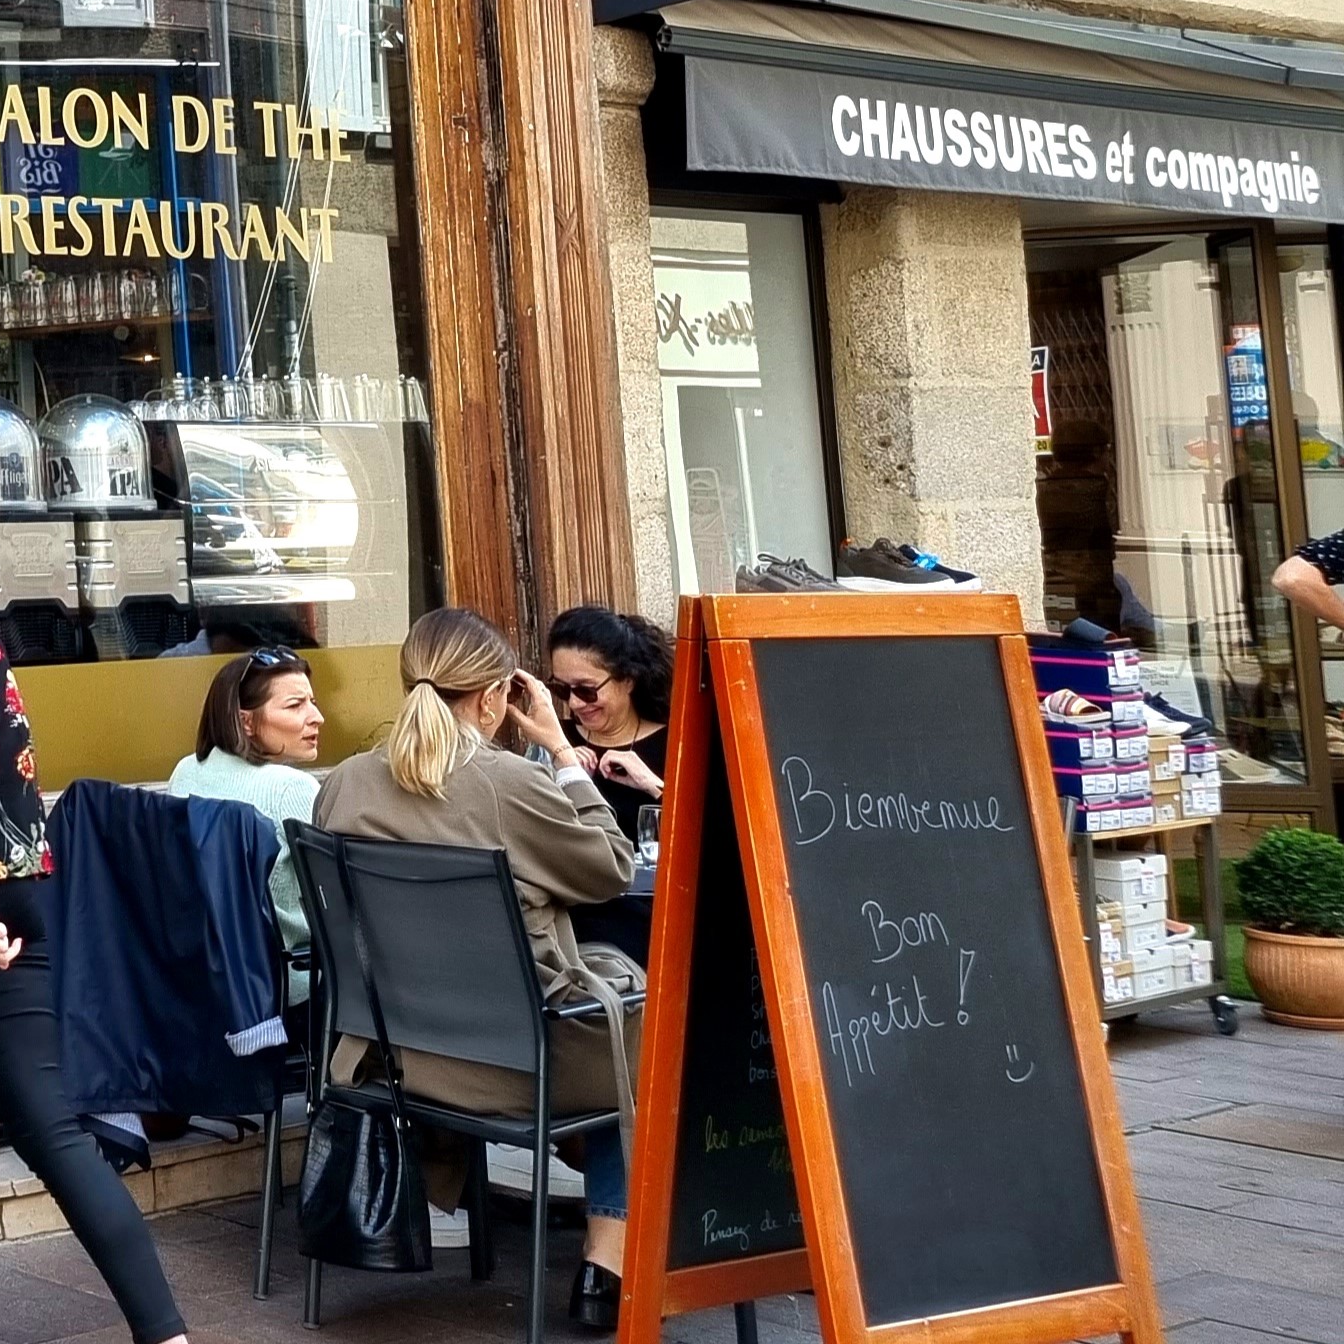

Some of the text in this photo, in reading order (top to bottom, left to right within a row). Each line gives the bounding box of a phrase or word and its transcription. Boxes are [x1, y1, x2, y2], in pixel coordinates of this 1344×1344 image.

[171, 94, 237, 155] DE
[830, 94, 1322, 214] CHAUSSURES et compagnie
[781, 755, 1016, 845] Bienvenue
[861, 900, 950, 964] Bon
